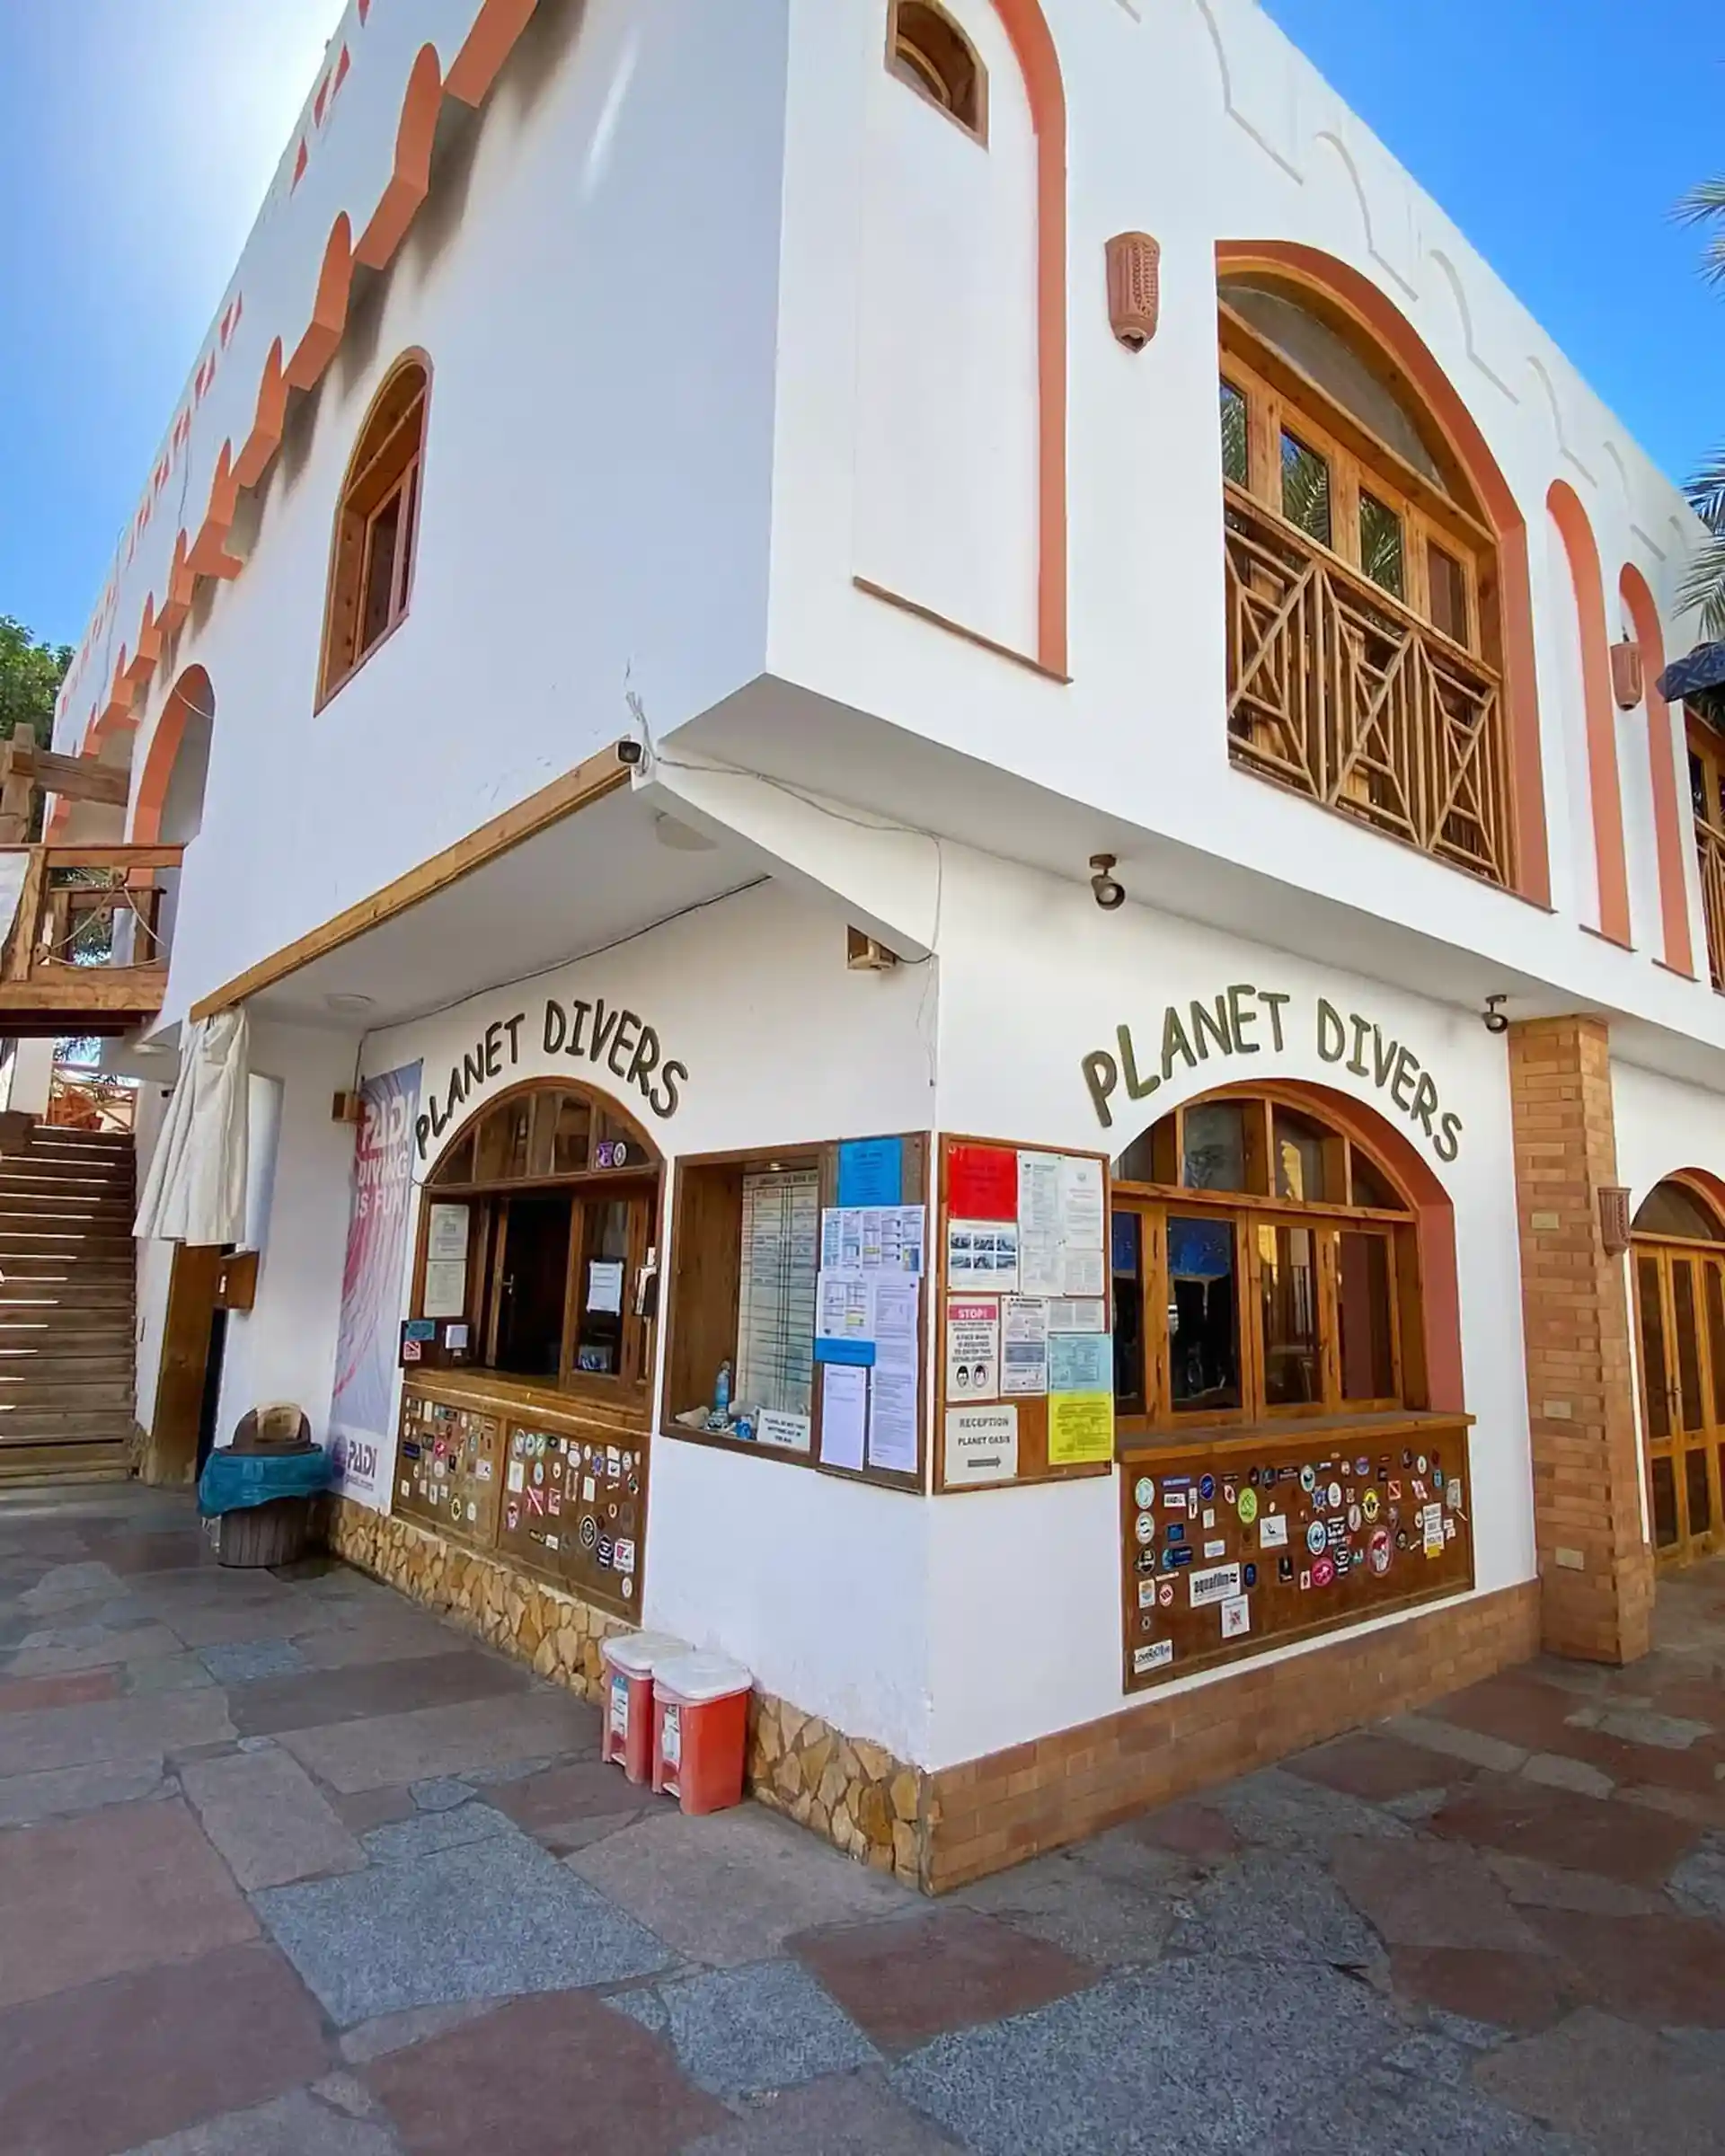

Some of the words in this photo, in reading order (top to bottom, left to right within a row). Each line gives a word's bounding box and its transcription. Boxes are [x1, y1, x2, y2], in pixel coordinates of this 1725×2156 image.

[415, 1012, 526, 1160] PLANET
[543, 999, 689, 1119] DIVERS
[1081, 984, 1291, 1128] PLANET
[1317, 997, 1464, 1162] DIVERS
[361, 1091, 414, 1152] PADI
[358, 1151, 409, 1188] DIVING
[374, 1183, 404, 1217] FUN
[958, 1436, 987, 1447] PLANET
[987, 1436, 1010, 1445] OASIS
[959, 1417, 1009, 1428] RECEPTION
[347, 1439, 378, 1479] PADI
